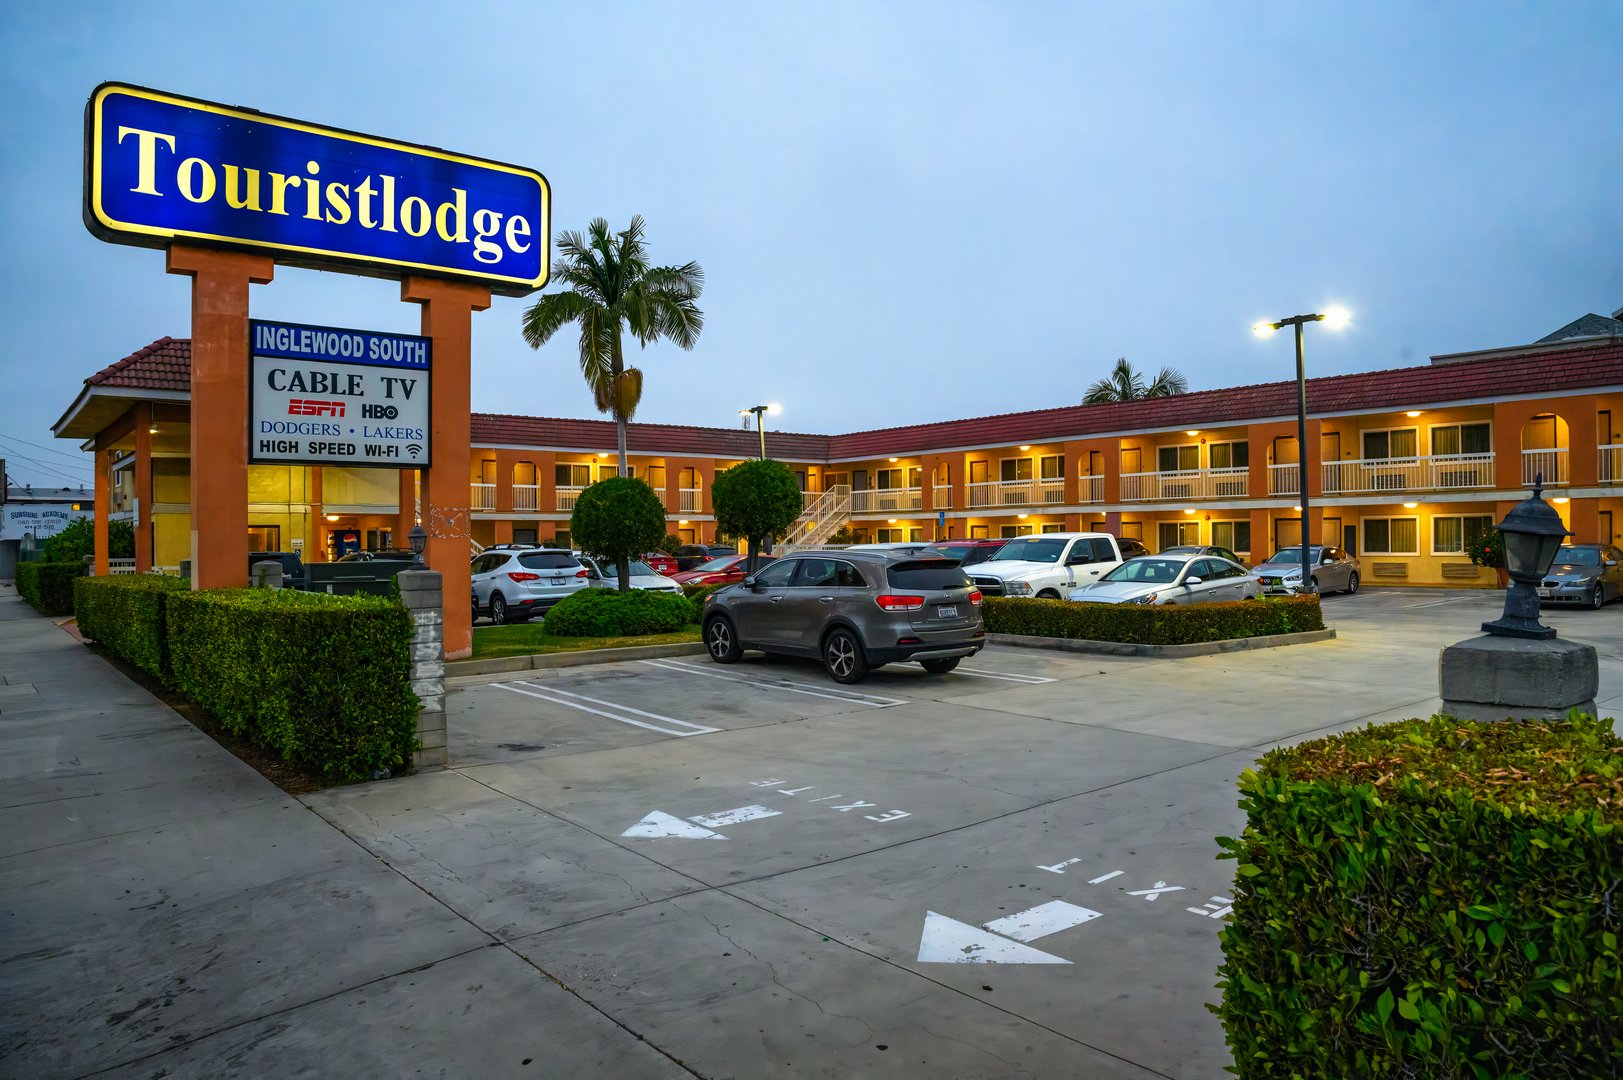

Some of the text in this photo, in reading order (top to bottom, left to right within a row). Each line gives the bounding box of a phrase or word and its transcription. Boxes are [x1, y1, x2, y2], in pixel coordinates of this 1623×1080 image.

[117, 125, 531, 264] Touristlodge
[256, 325, 426, 364] INGLEWOOD SOUTH
[267, 368, 417, 400] CABLE TV
[288, 399, 399, 420] ESPN HBO
[260, 420, 423, 440] DODGERS LAKERS
[259, 440, 399, 458] HIGH SPEED WI-FI
[10, 511, 69, 520] SUNSHINE ACADEMY
